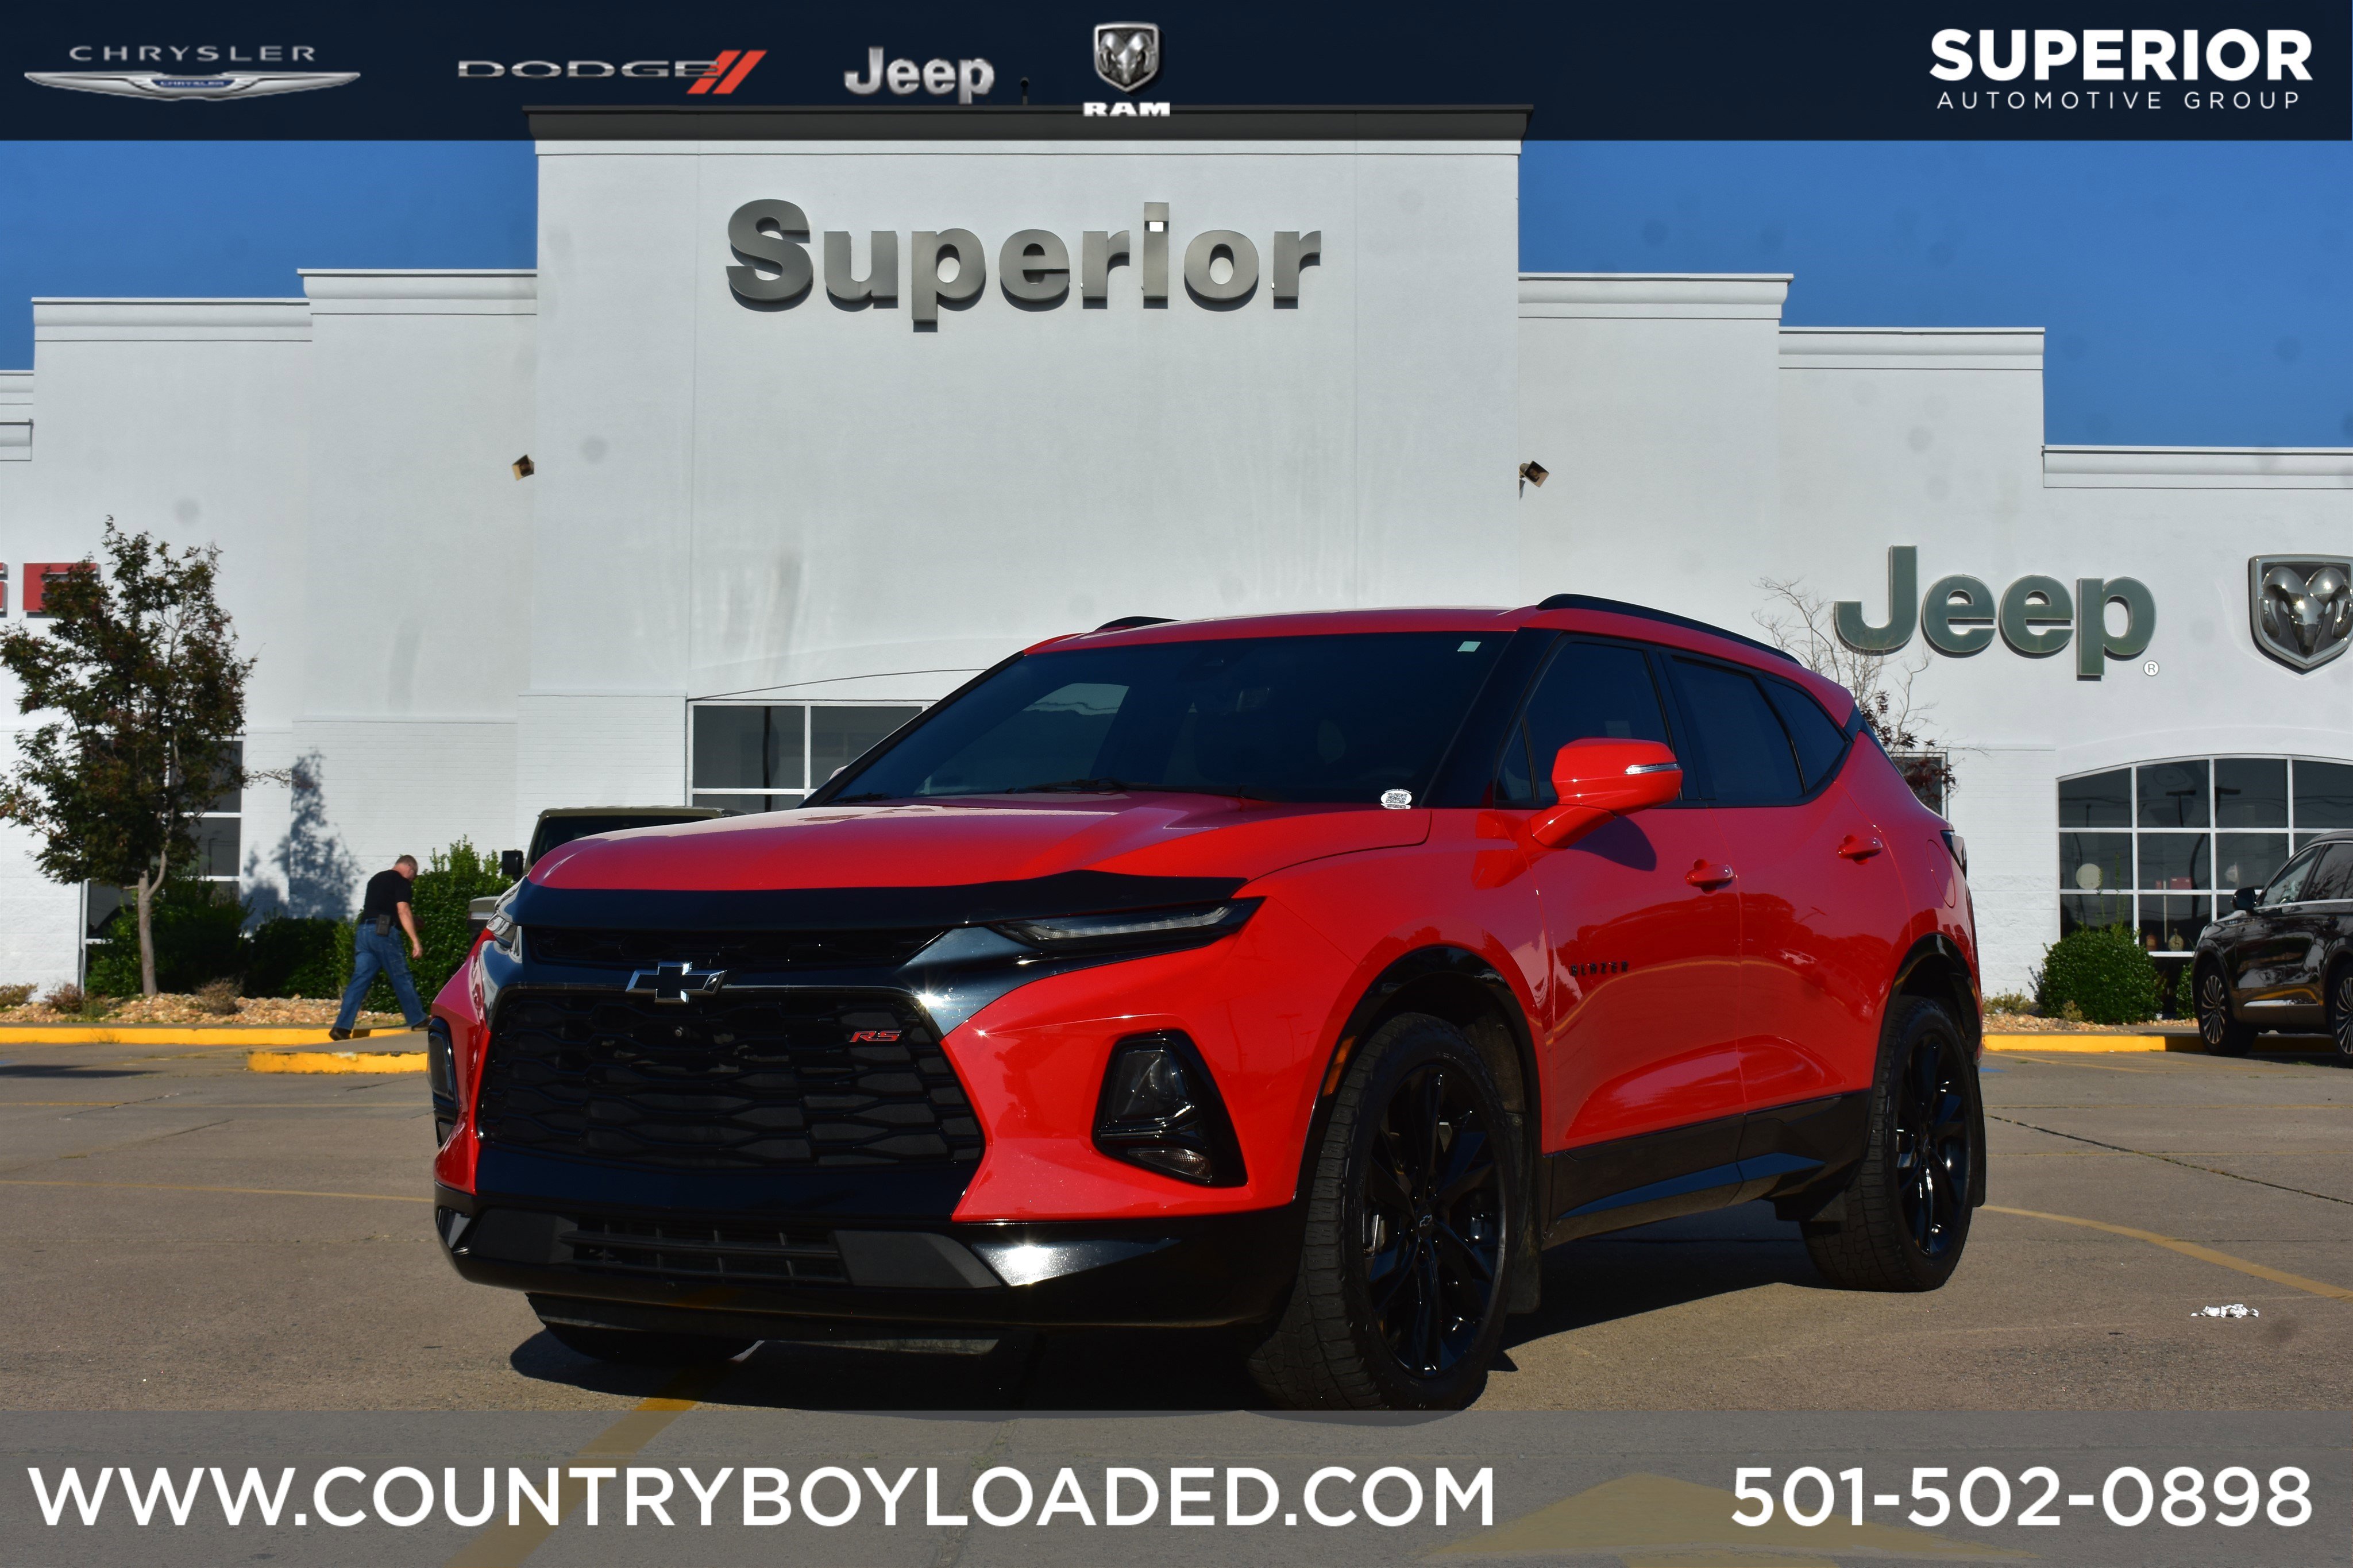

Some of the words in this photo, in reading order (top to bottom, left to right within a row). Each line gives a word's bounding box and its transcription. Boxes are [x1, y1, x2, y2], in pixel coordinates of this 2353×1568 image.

[726, 199, 1321, 327] Superior
[1834, 546, 2157, 678] Jeep
[1571, 960, 1629, 977] BLAZER
[849, 1030, 902, 1042] RS
